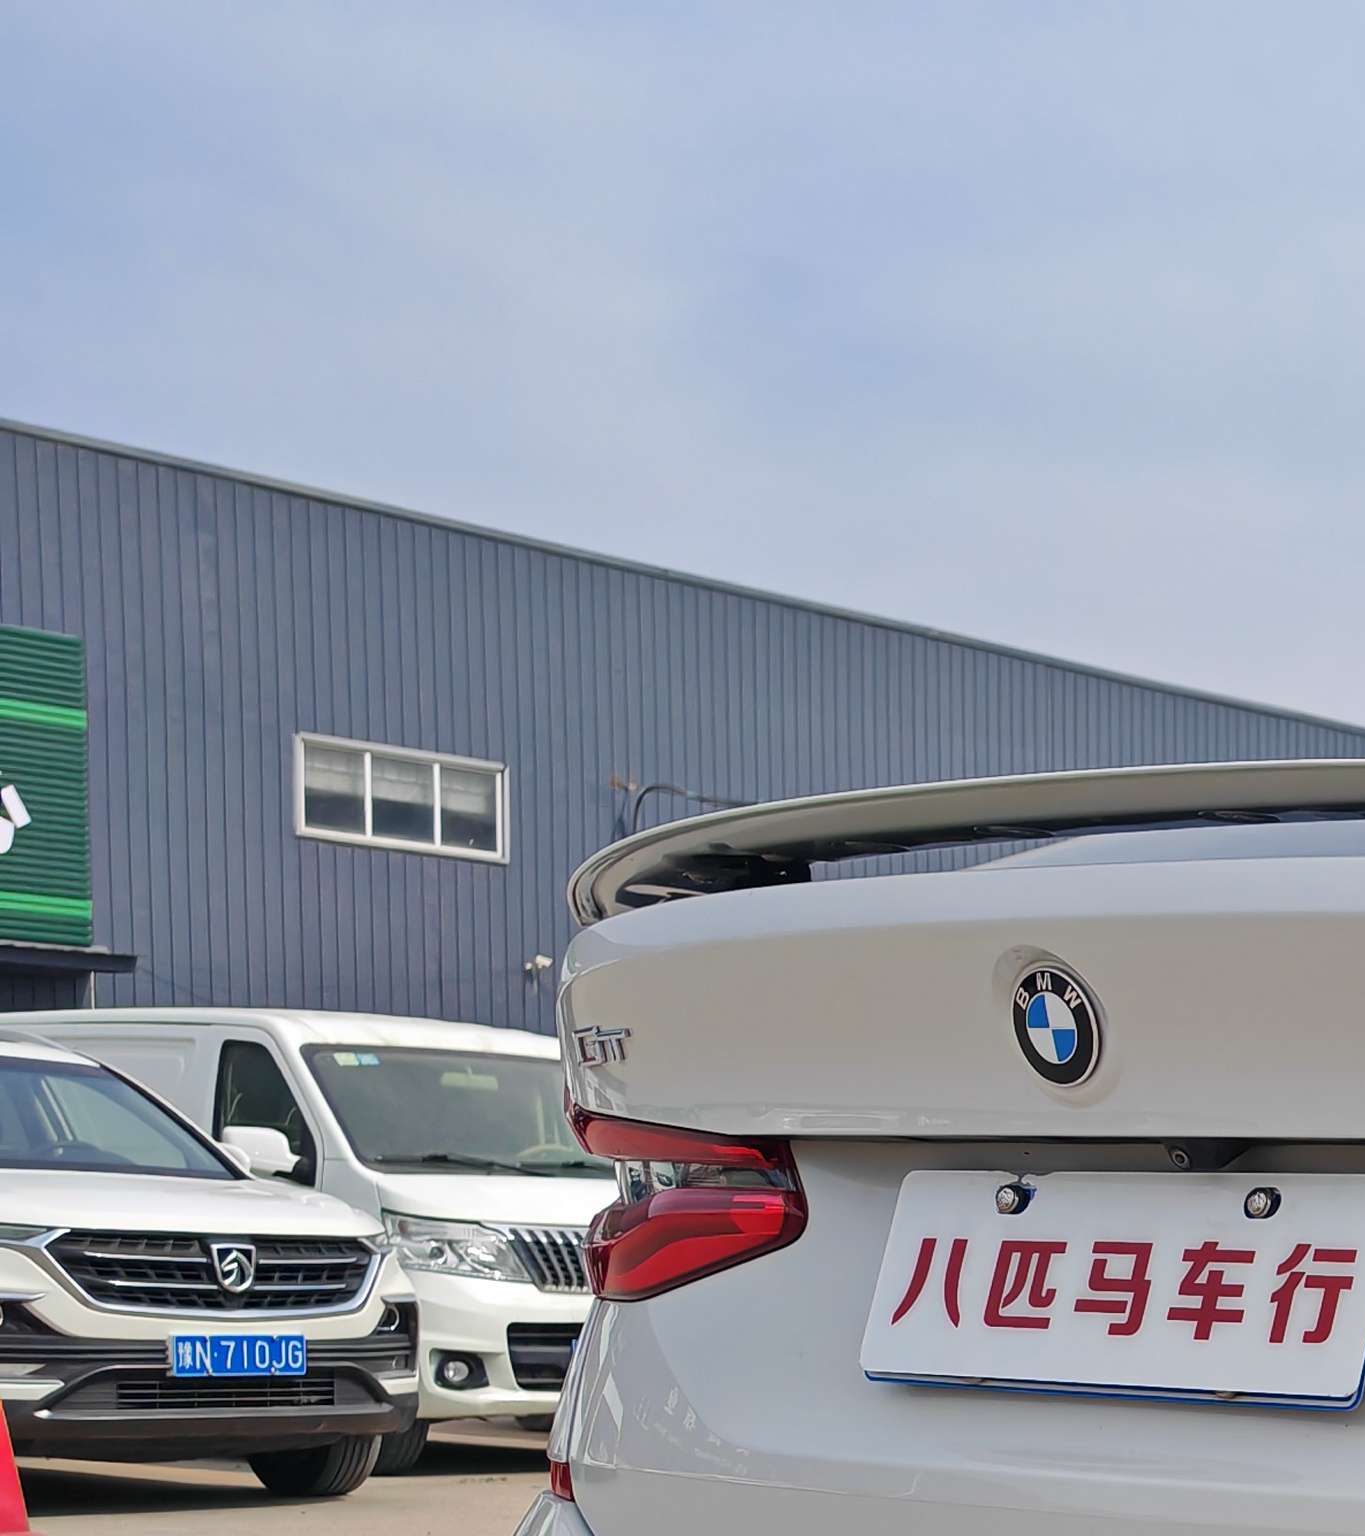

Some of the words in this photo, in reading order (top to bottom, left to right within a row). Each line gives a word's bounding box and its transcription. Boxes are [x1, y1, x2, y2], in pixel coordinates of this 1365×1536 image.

[1015, 972, 1082, 1010] BMW
[890, 1237, 1358, 1344] 八匹马车行
